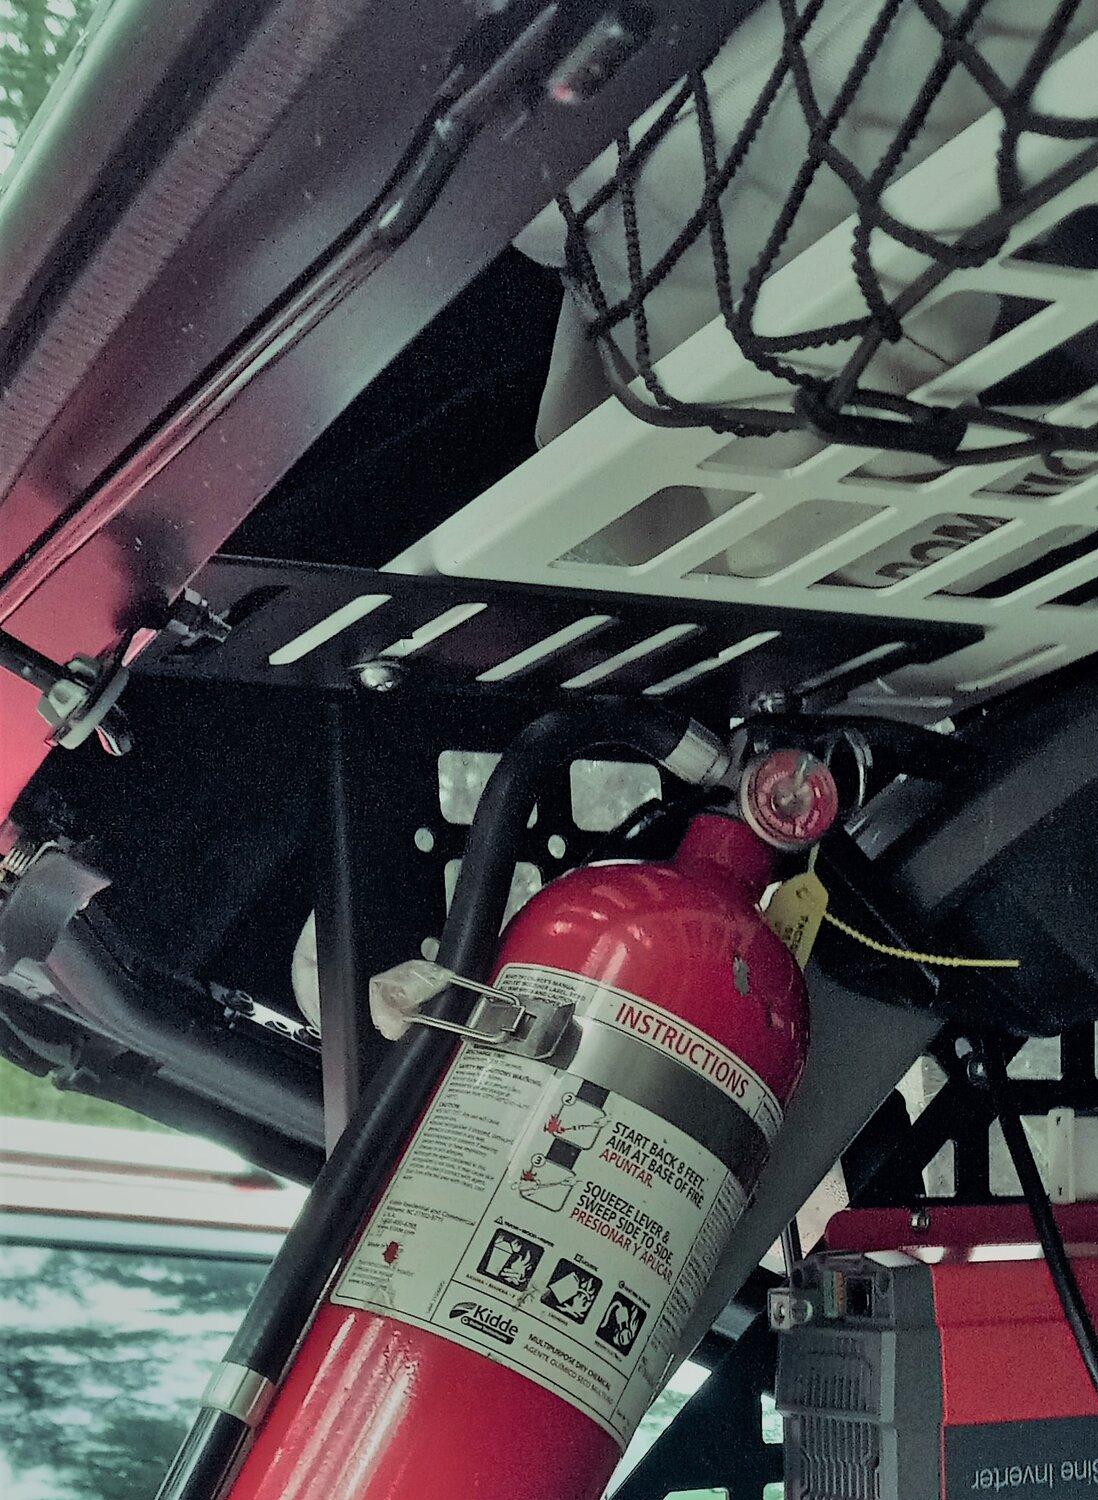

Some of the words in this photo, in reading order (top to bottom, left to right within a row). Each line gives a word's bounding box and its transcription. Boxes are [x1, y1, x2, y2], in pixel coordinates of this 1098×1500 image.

[614, 1002, 749, 1098] INSTRUCTIONS
[606, 1136, 631, 1158] AIM
[632, 1151, 649, 1168] AT
[648, 1161, 676, 1188] BASE
[674, 1181, 688, 1197] OF
[686, 1186, 704, 1210] FIRE.
[612, 1122, 648, 1149] START
[650, 1142, 679, 1171] BACK
[677, 1162, 684, 1174] 8
[570, 1208, 632, 1251] PRESIONAR
[631, 1243, 642, 1257] Y
[577, 1195, 616, 1223] SWEEP
[616, 1216, 643, 1239] SIDE
[641, 1232, 654, 1249] TO
[655, 1240, 674, 1266] SIDE.
[583, 1181, 635, 1218] SQUEEZE
[634, 1208, 663, 1238] LEVER
[662, 1231, 671, 1244] &
[473, 1305, 519, 1337] Kidde
[523, 1344, 549, 1364] AGENTE
[528, 1333, 576, 1366] MULTIPURPOSE
[575, 1361, 589, 1374] DRY
[970, 1462, 1055, 1491] Inverter
